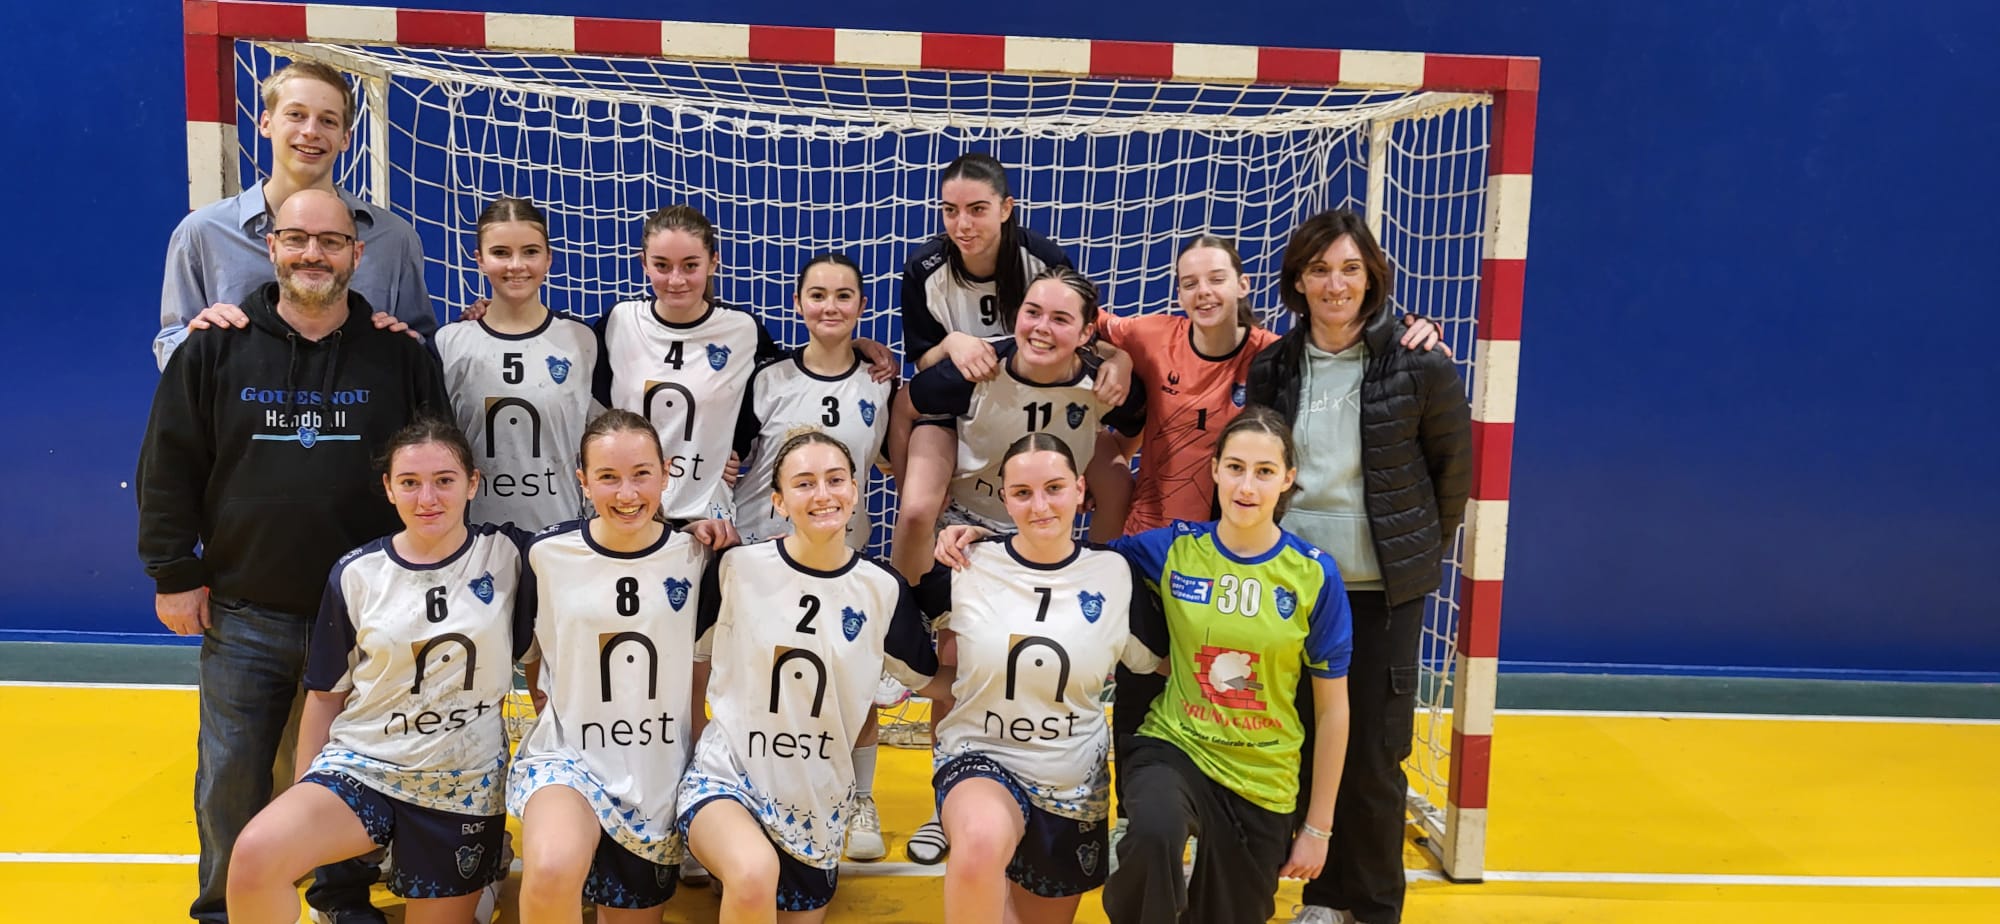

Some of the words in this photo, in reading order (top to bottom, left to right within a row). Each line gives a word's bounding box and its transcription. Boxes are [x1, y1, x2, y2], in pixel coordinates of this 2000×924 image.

[980, 295, 997, 326] 9
[502, 352, 524, 385] 5
[663, 341, 685, 370] 4
[265, 409, 346, 428] Handbll
[821, 396, 841, 428] 3
[1023, 401, 1053, 432] 11
[1196, 408, 1207, 431] 1
[425, 585, 448, 623] 6
[616, 576, 640, 617] 8
[1034, 587, 1052, 622] 7
[1217, 573, 1262, 617] 30
[795, 594, 821, 635] 2
[384, 700, 490, 735] nest
[582, 712, 675, 750] nest
[984, 710, 1080, 742] nest
[749, 731, 834, 760] nest
